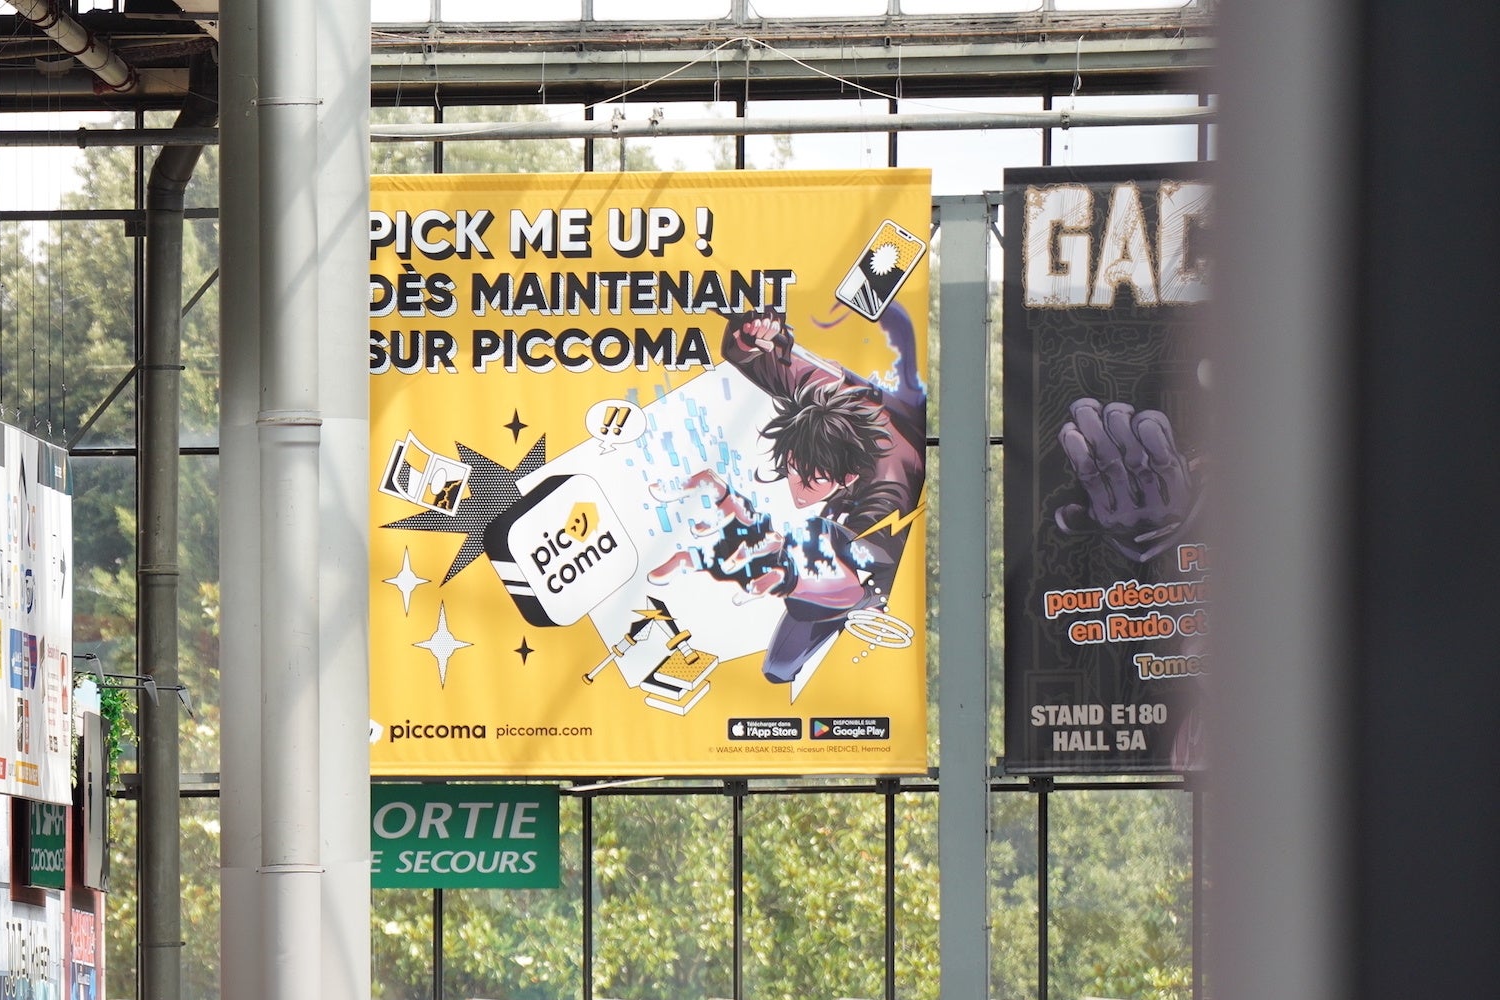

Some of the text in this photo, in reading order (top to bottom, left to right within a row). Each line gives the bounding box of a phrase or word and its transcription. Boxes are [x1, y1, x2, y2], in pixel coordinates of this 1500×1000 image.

[369, 209, 494, 260] PICK
[510, 208, 592, 259] ME
[607, 207, 685, 258] UP
[369, 263, 796, 317] DÈS MAINTENANT
[369, 327, 715, 375] SUR PICCOMA
[530, 529, 573, 575] pic
[546, 531, 619, 595] coma
[1044, 589, 1104, 619] pour
[1068, 620, 1103, 645] en
[1107, 611, 1177, 643] Rudo
[1031, 703, 1167, 726] STAND E180
[390, 720, 592, 743] piccoma piccoma.com
[773, 727, 798, 737] Store
[833, 726, 886, 738] Google Play
[1053, 730, 1147, 752] HALL 5A
[797, 745, 825, 753] nicesun
[861, 745, 891, 753] Hermod
[395, 850, 538, 874] SECOURS
